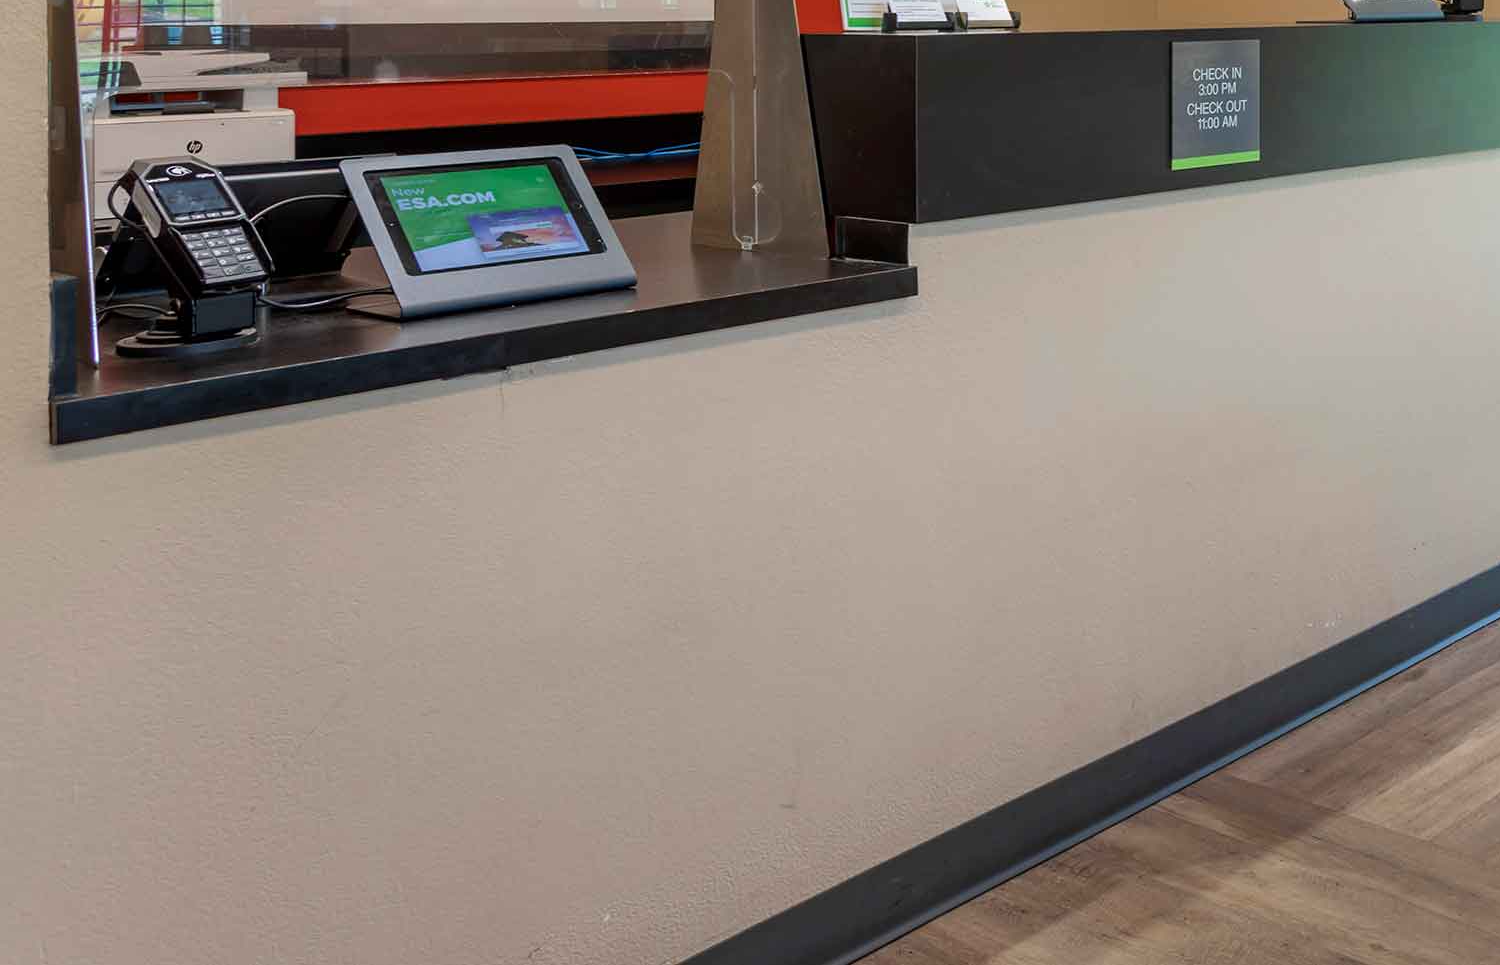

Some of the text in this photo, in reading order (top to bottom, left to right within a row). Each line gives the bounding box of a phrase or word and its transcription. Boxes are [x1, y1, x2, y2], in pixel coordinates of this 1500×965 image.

[1192, 67, 1242, 81] CHECK IN
[1198, 82, 1237, 96] 3:00 PM
[1187, 99, 1247, 116] CHECK OUT
[1198, 115, 1238, 130] 11:00 AM
[187, 140, 202, 154] hp
[391, 186, 425, 197] New
[397, 191, 496, 211] ESA.COM
